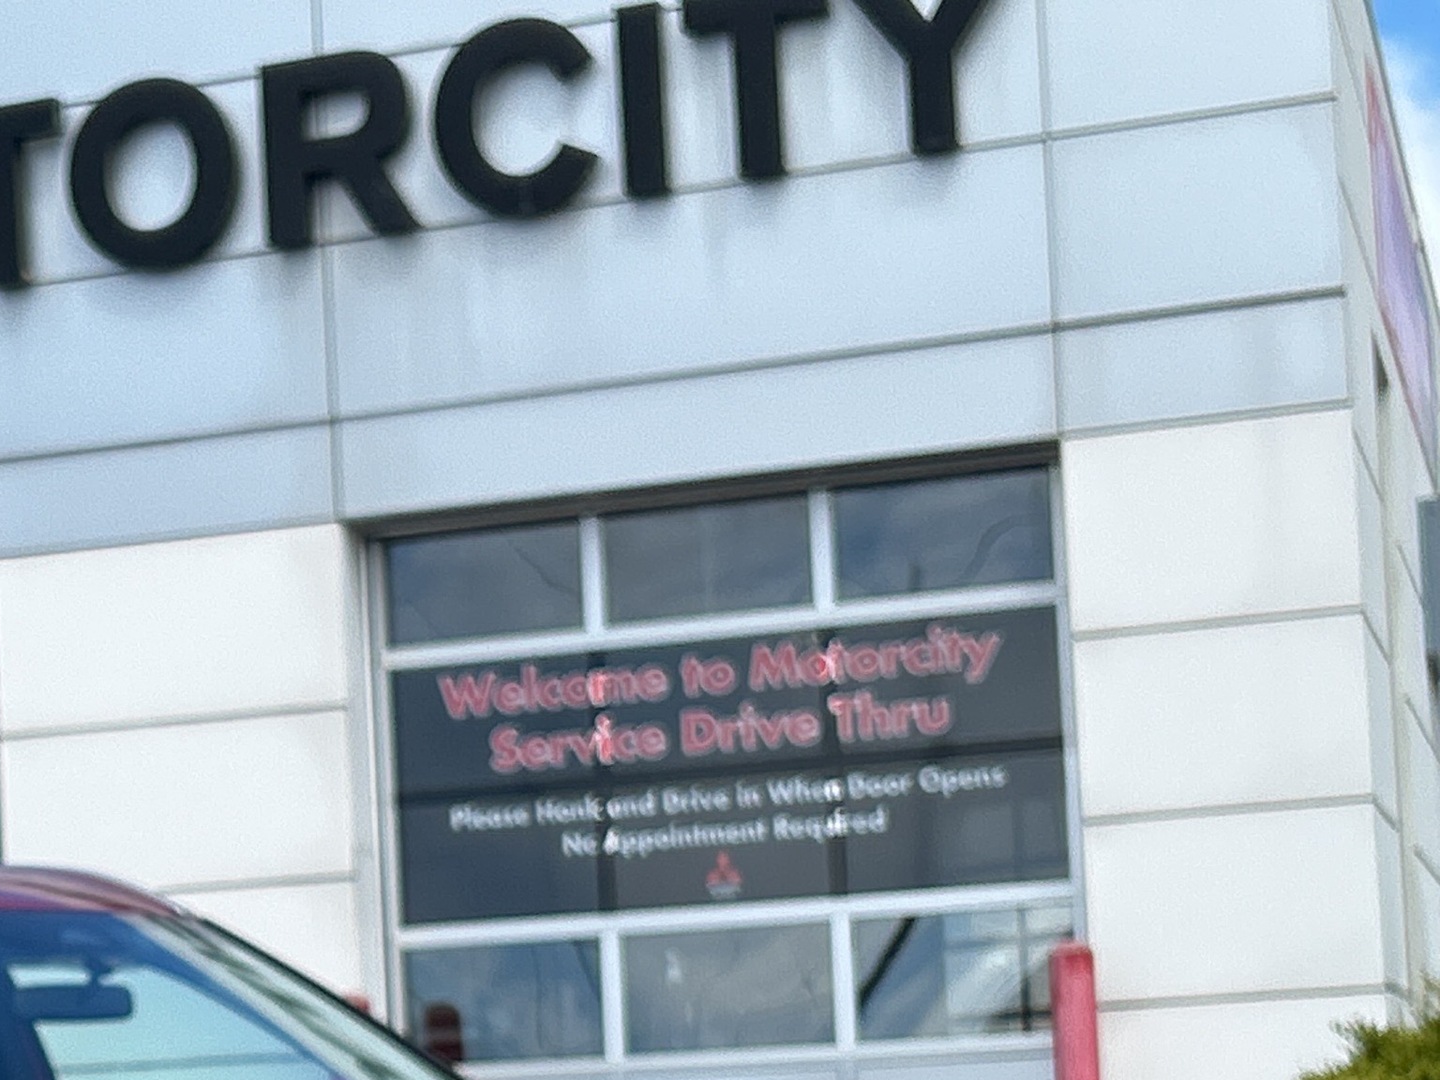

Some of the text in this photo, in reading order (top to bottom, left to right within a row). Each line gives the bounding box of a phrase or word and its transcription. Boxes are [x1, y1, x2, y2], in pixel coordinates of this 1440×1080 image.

[438, 624, 1002, 720] Welcome to Motorcity
[488, 690, 953, 775] Service Drive Thru
[450, 803, 530, 831] Please
[662, 784, 730, 815] Drive
[766, 775, 844, 804] When
[918, 764, 1007, 798] Opens
[562, 803, 889, 857] No Appointment Required
